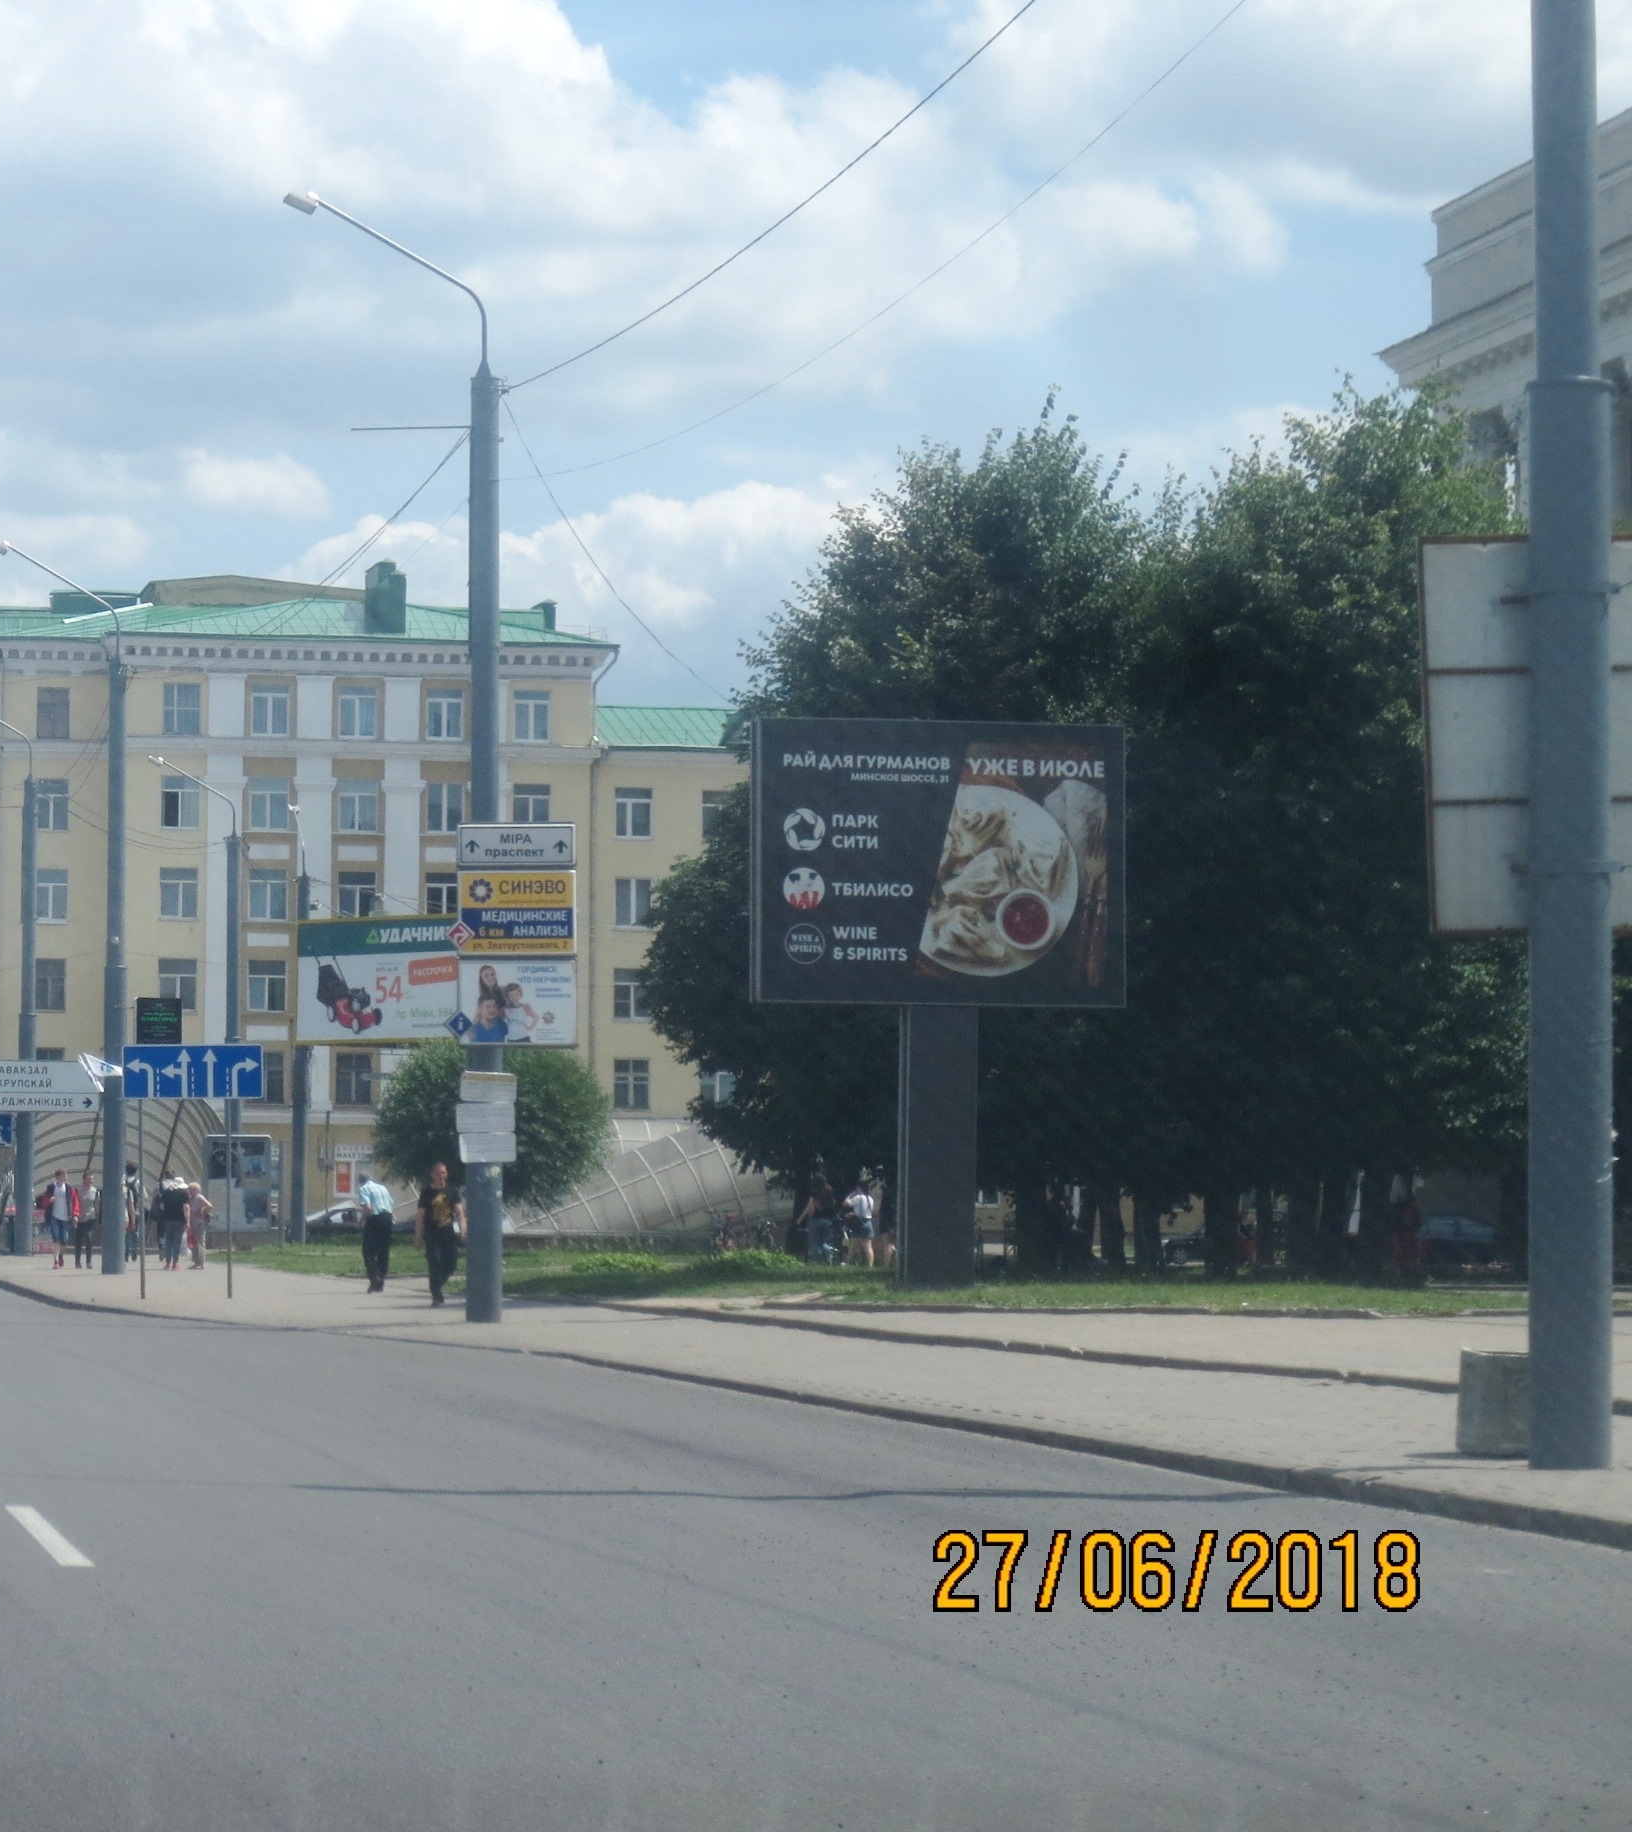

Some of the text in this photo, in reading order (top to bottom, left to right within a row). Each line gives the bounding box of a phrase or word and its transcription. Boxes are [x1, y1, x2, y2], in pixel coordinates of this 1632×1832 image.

[783, 751, 951, 770] РАЙ ДЛЯ ГУРМАНОВ
[966, 758, 1105, 778] УЖЕ В ИЮЛЕ
[850, 772, 950, 784] МИНСКОЕ ШОССЕ, 31
[831, 814, 879, 829] ПАРК
[500, 834, 532, 844] МІРА
[831, 835, 879, 849] СИТИ
[485, 848, 545, 859] праспект
[499, 880, 566, 895] СИНЭВО
[831, 883, 914, 897] ТБИЛИСО
[482, 910, 568, 923] МЕДИЦИНСКИЕ
[380, 926, 452, 944] УДАЧНИ
[513, 925, 568, 937] АНАЛИЗЫ
[833, 926, 878, 940] WINE
[833, 946, 908, 962] & SPIRITS
[375, 976, 403, 1004] 54
